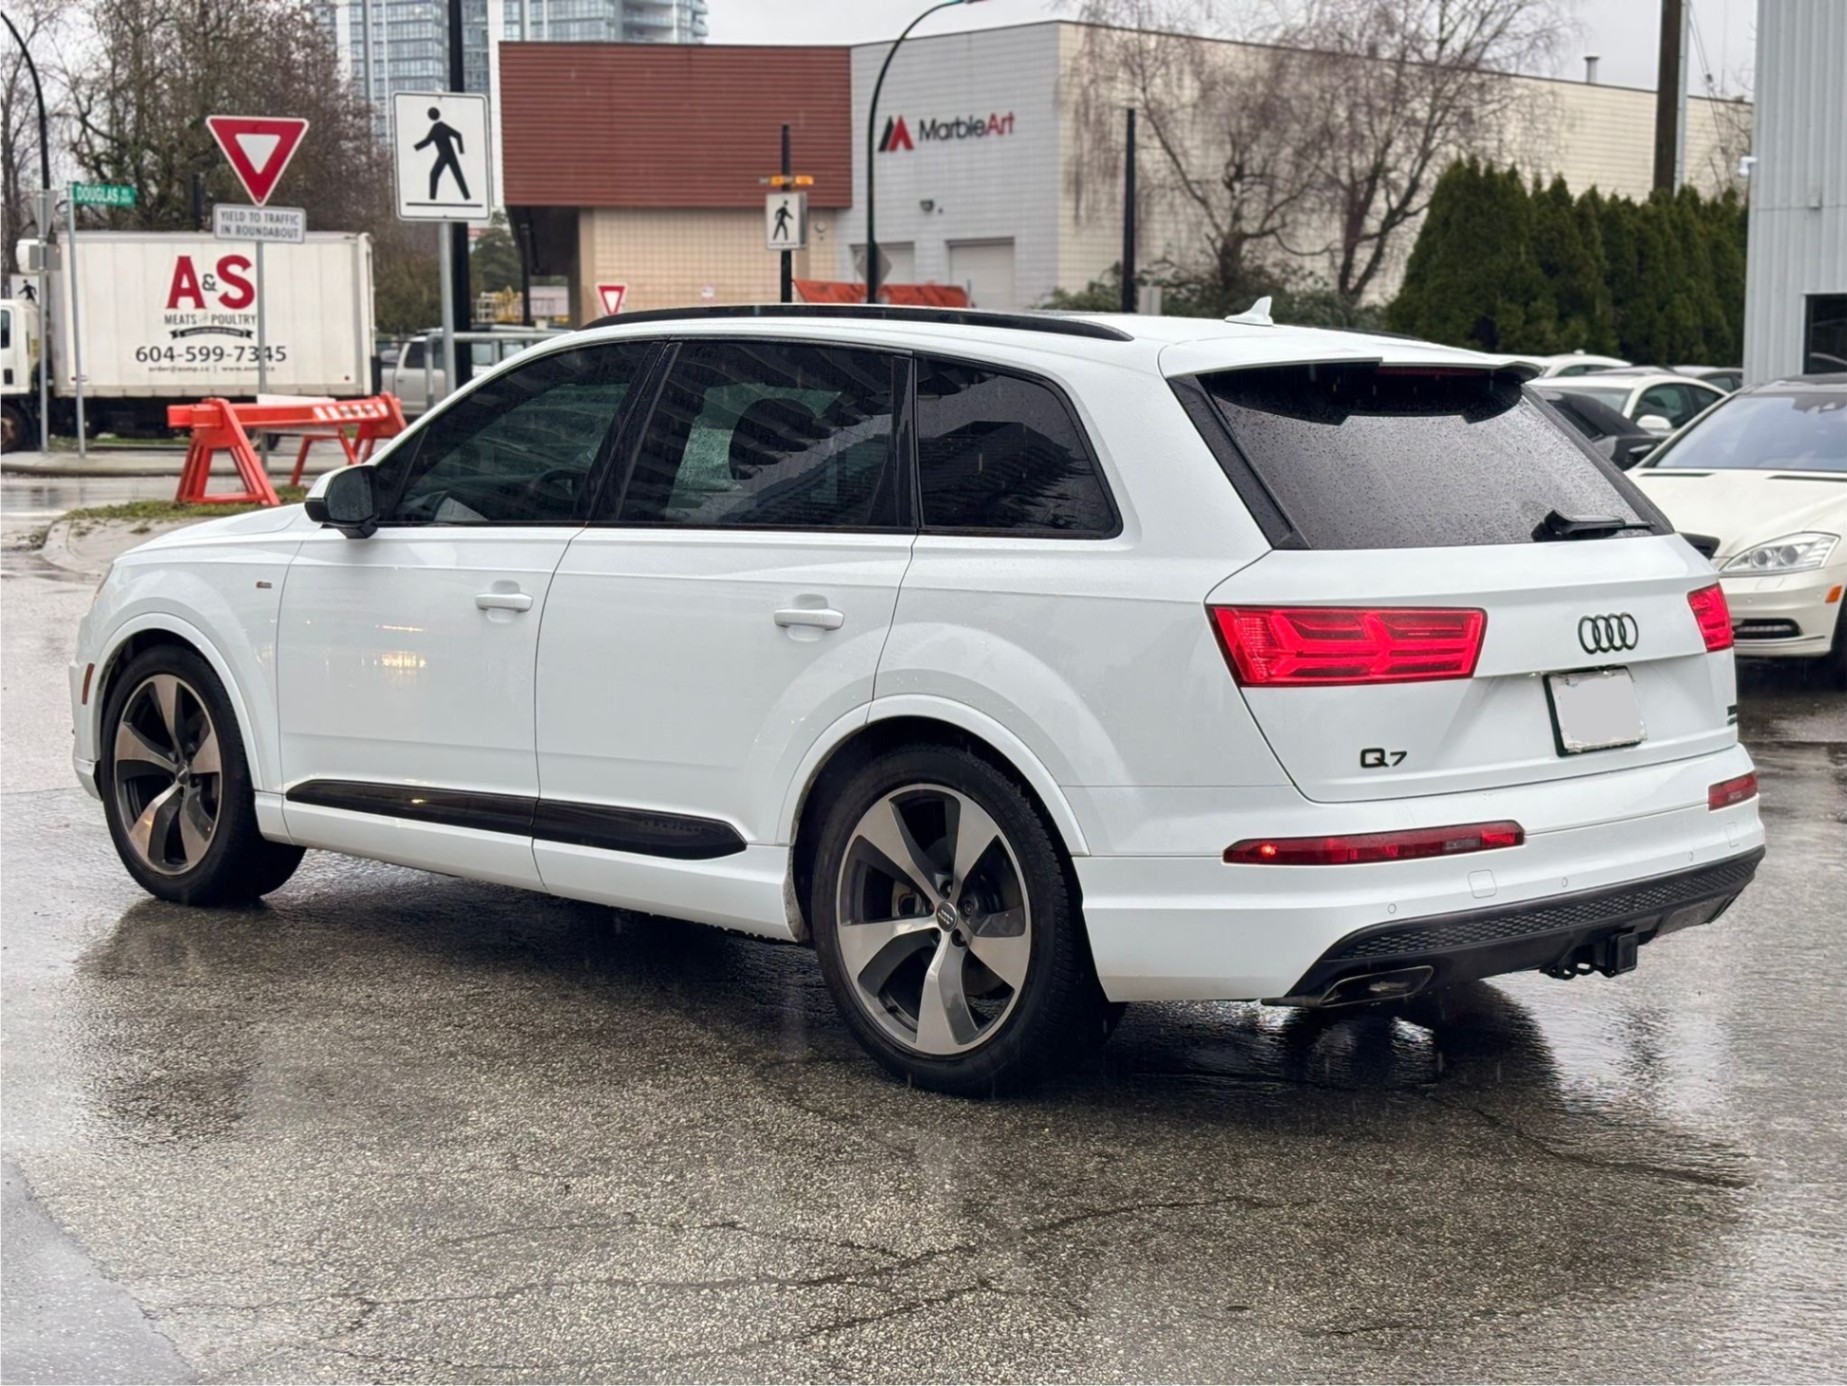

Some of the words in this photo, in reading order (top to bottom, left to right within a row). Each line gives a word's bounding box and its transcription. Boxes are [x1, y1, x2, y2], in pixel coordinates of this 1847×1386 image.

[919, 111, 1015, 141] MarbleArt
[76, 185, 118, 203] DOUGLAS
[220, 211, 246, 223] YIELD
[249, 212, 261, 223] TO
[264, 213, 299, 225] TRAFFIC
[221, 224, 232, 236] IN
[236, 225, 299, 238] ROUNDABOUT
[164, 313, 198, 325] MEATS
[211, 313, 257, 325] POULTRY
[135, 345, 287, 363] 604-599-7345
[1360, 747, 1408, 769] Q7
